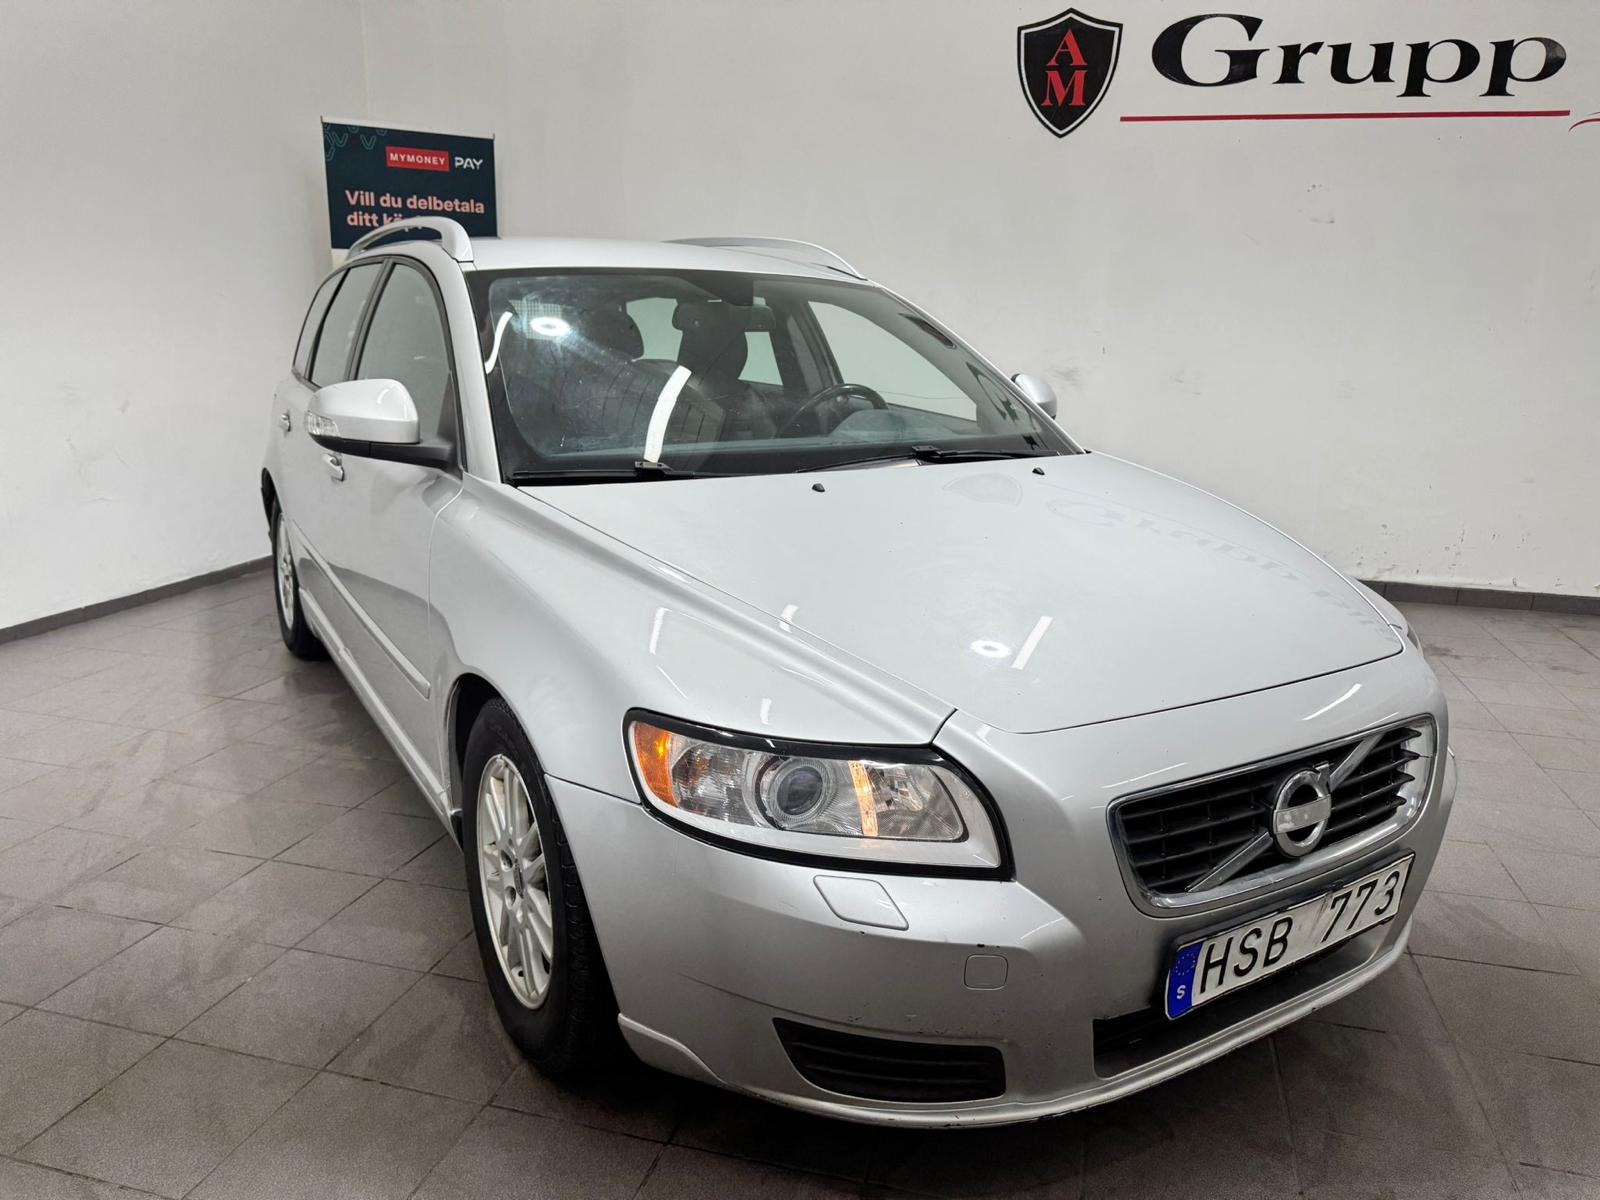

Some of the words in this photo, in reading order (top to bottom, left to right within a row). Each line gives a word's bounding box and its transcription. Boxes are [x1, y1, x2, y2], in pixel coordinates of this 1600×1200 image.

[1151, 12, 1567, 99] Grupp
[390, 153, 446, 165] MYMONEY
[454, 157, 483, 170] PAY
[345, 189, 375, 207] Vill
[379, 193, 403, 208] du
[406, 195, 485, 214] delbetala
[346, 211, 379, 227] ditt
[1199, 915, 1294, 995] HSB
[1320, 870, 1401, 944] 773
[1176, 984, 1186, 1000] S
